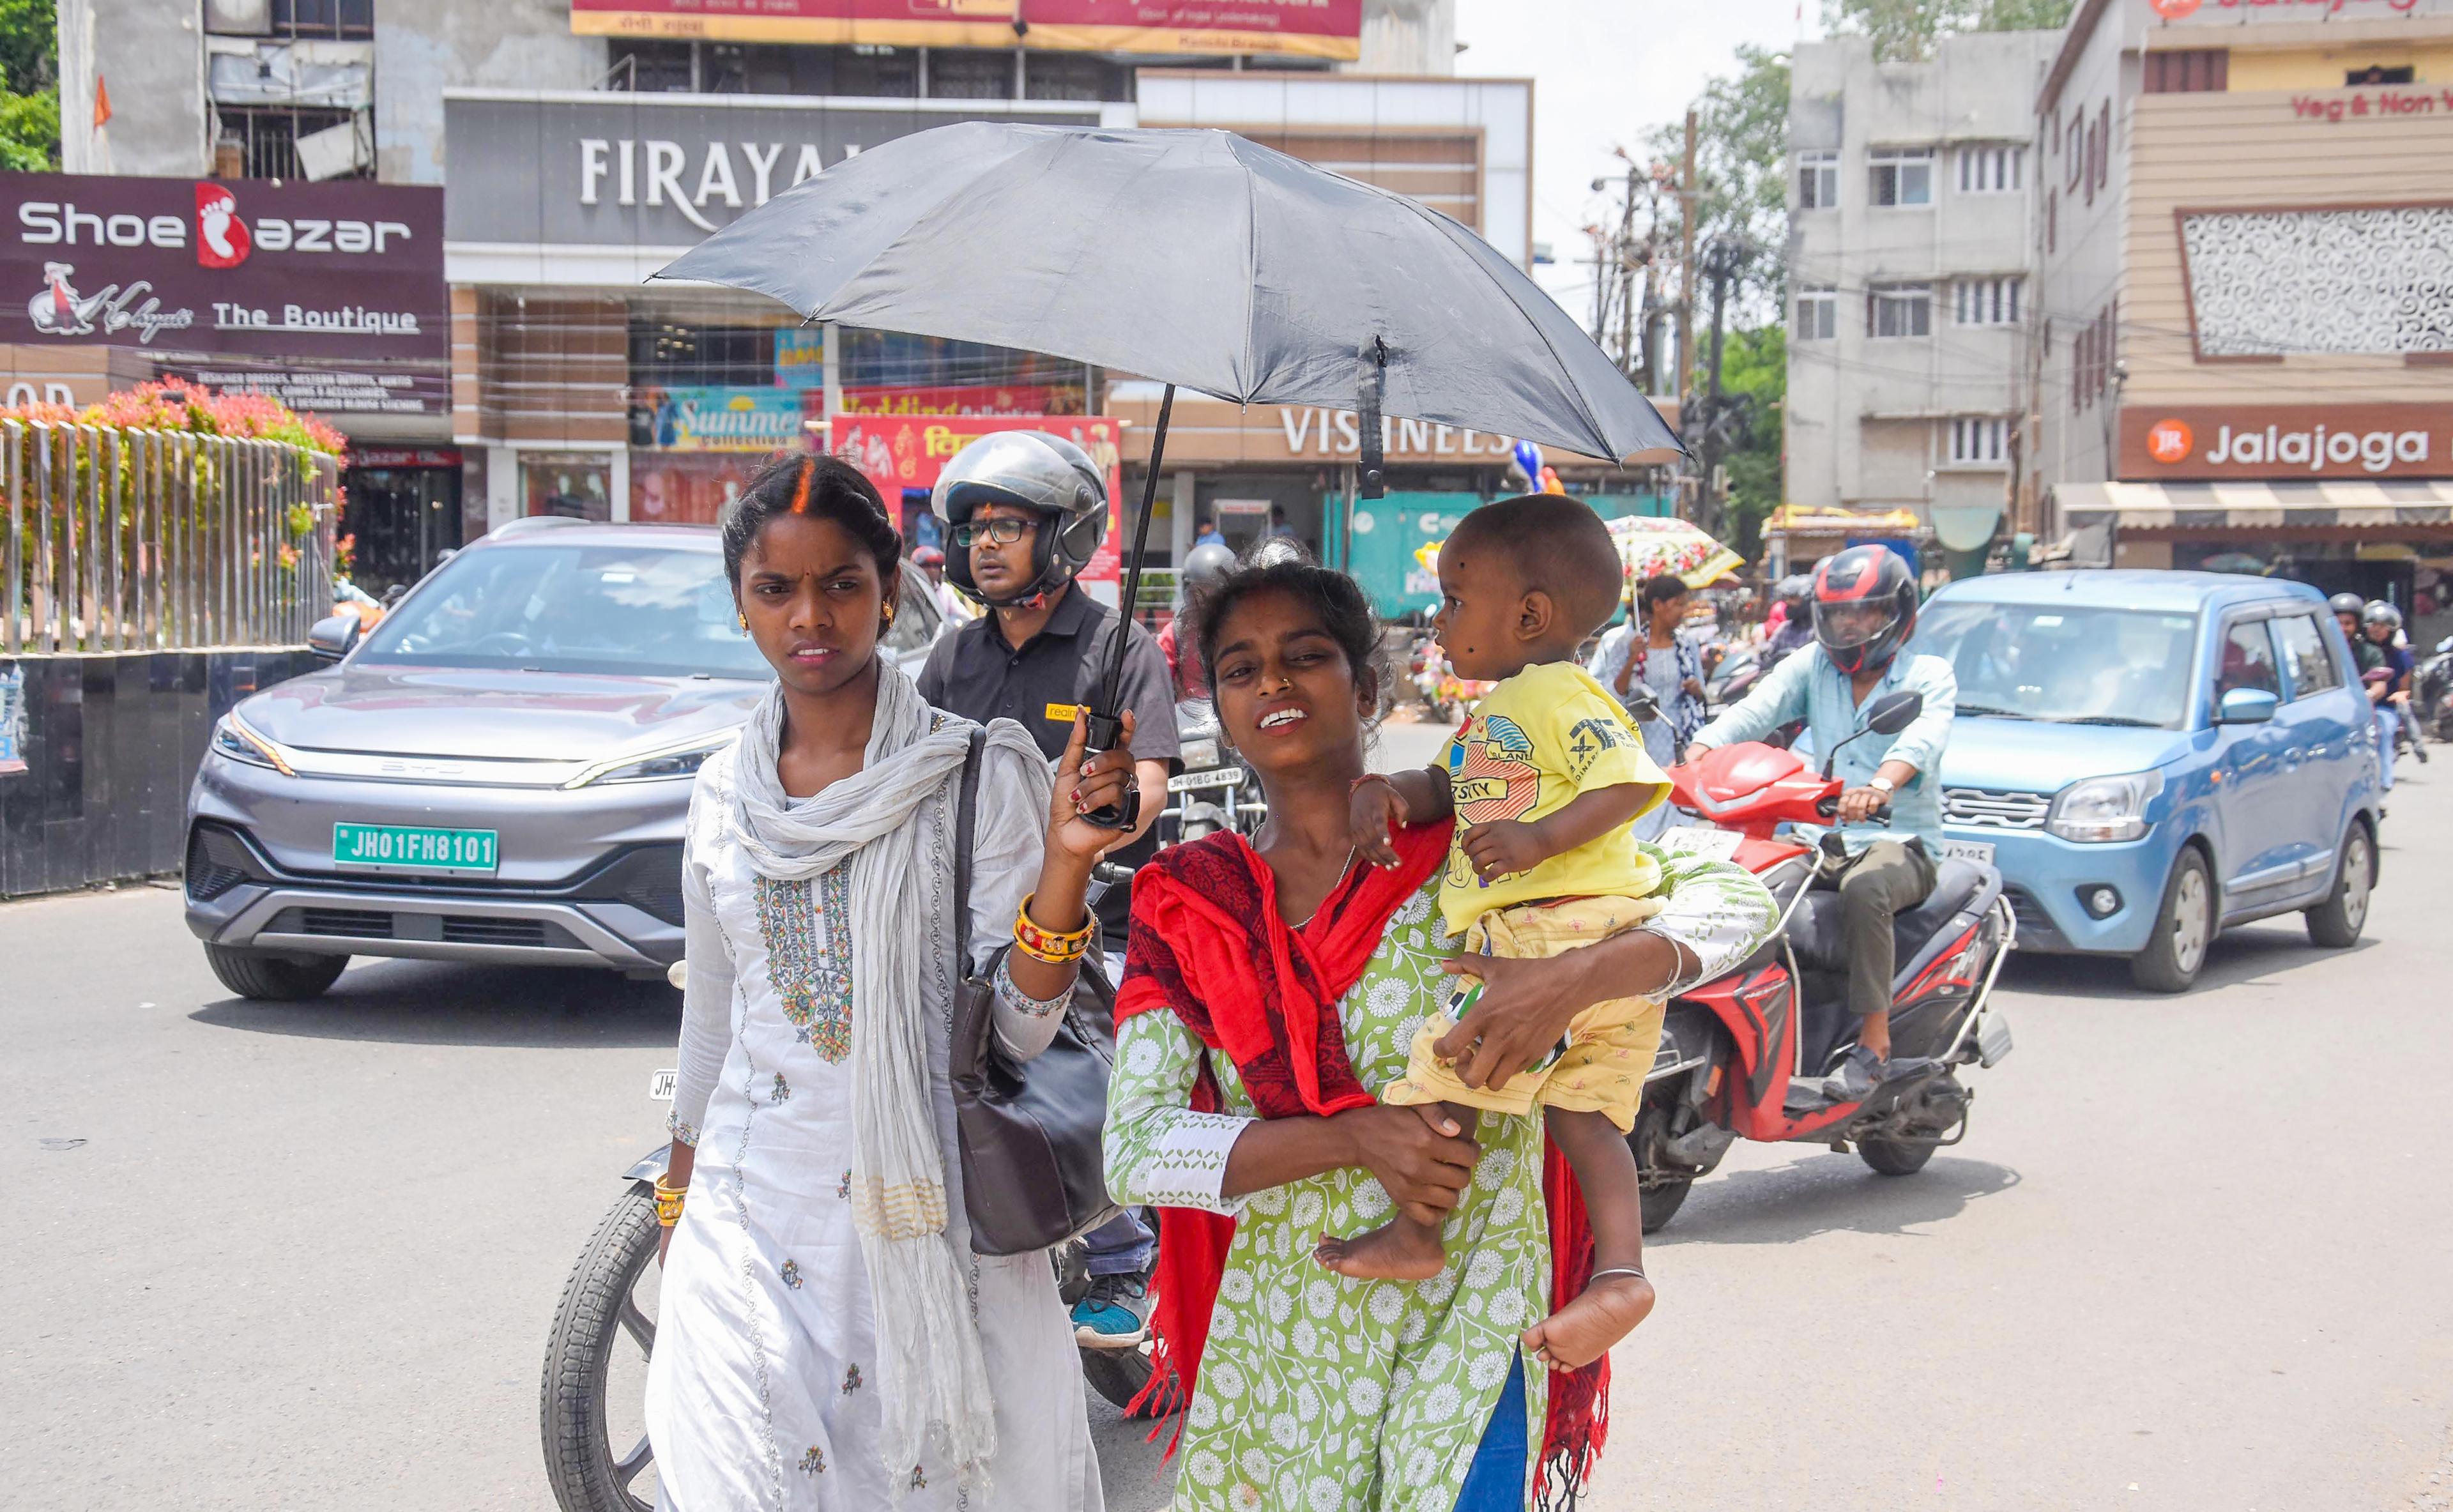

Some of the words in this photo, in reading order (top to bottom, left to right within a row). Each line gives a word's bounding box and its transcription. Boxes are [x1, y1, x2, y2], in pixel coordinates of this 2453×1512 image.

[2291, 95, 2344, 123] Veg
[2379, 91, 2434, 114] Non
[580, 139, 861, 233] FIRAYA
[19, 202, 187, 248] Shoe
[213, 303, 268, 327] The
[284, 304, 418, 335] Boutique
[0, 381, 75, 410] OD
[681, 399, 802, 433] Summe
[2206, 424, 2429, 473] Jalajoga
